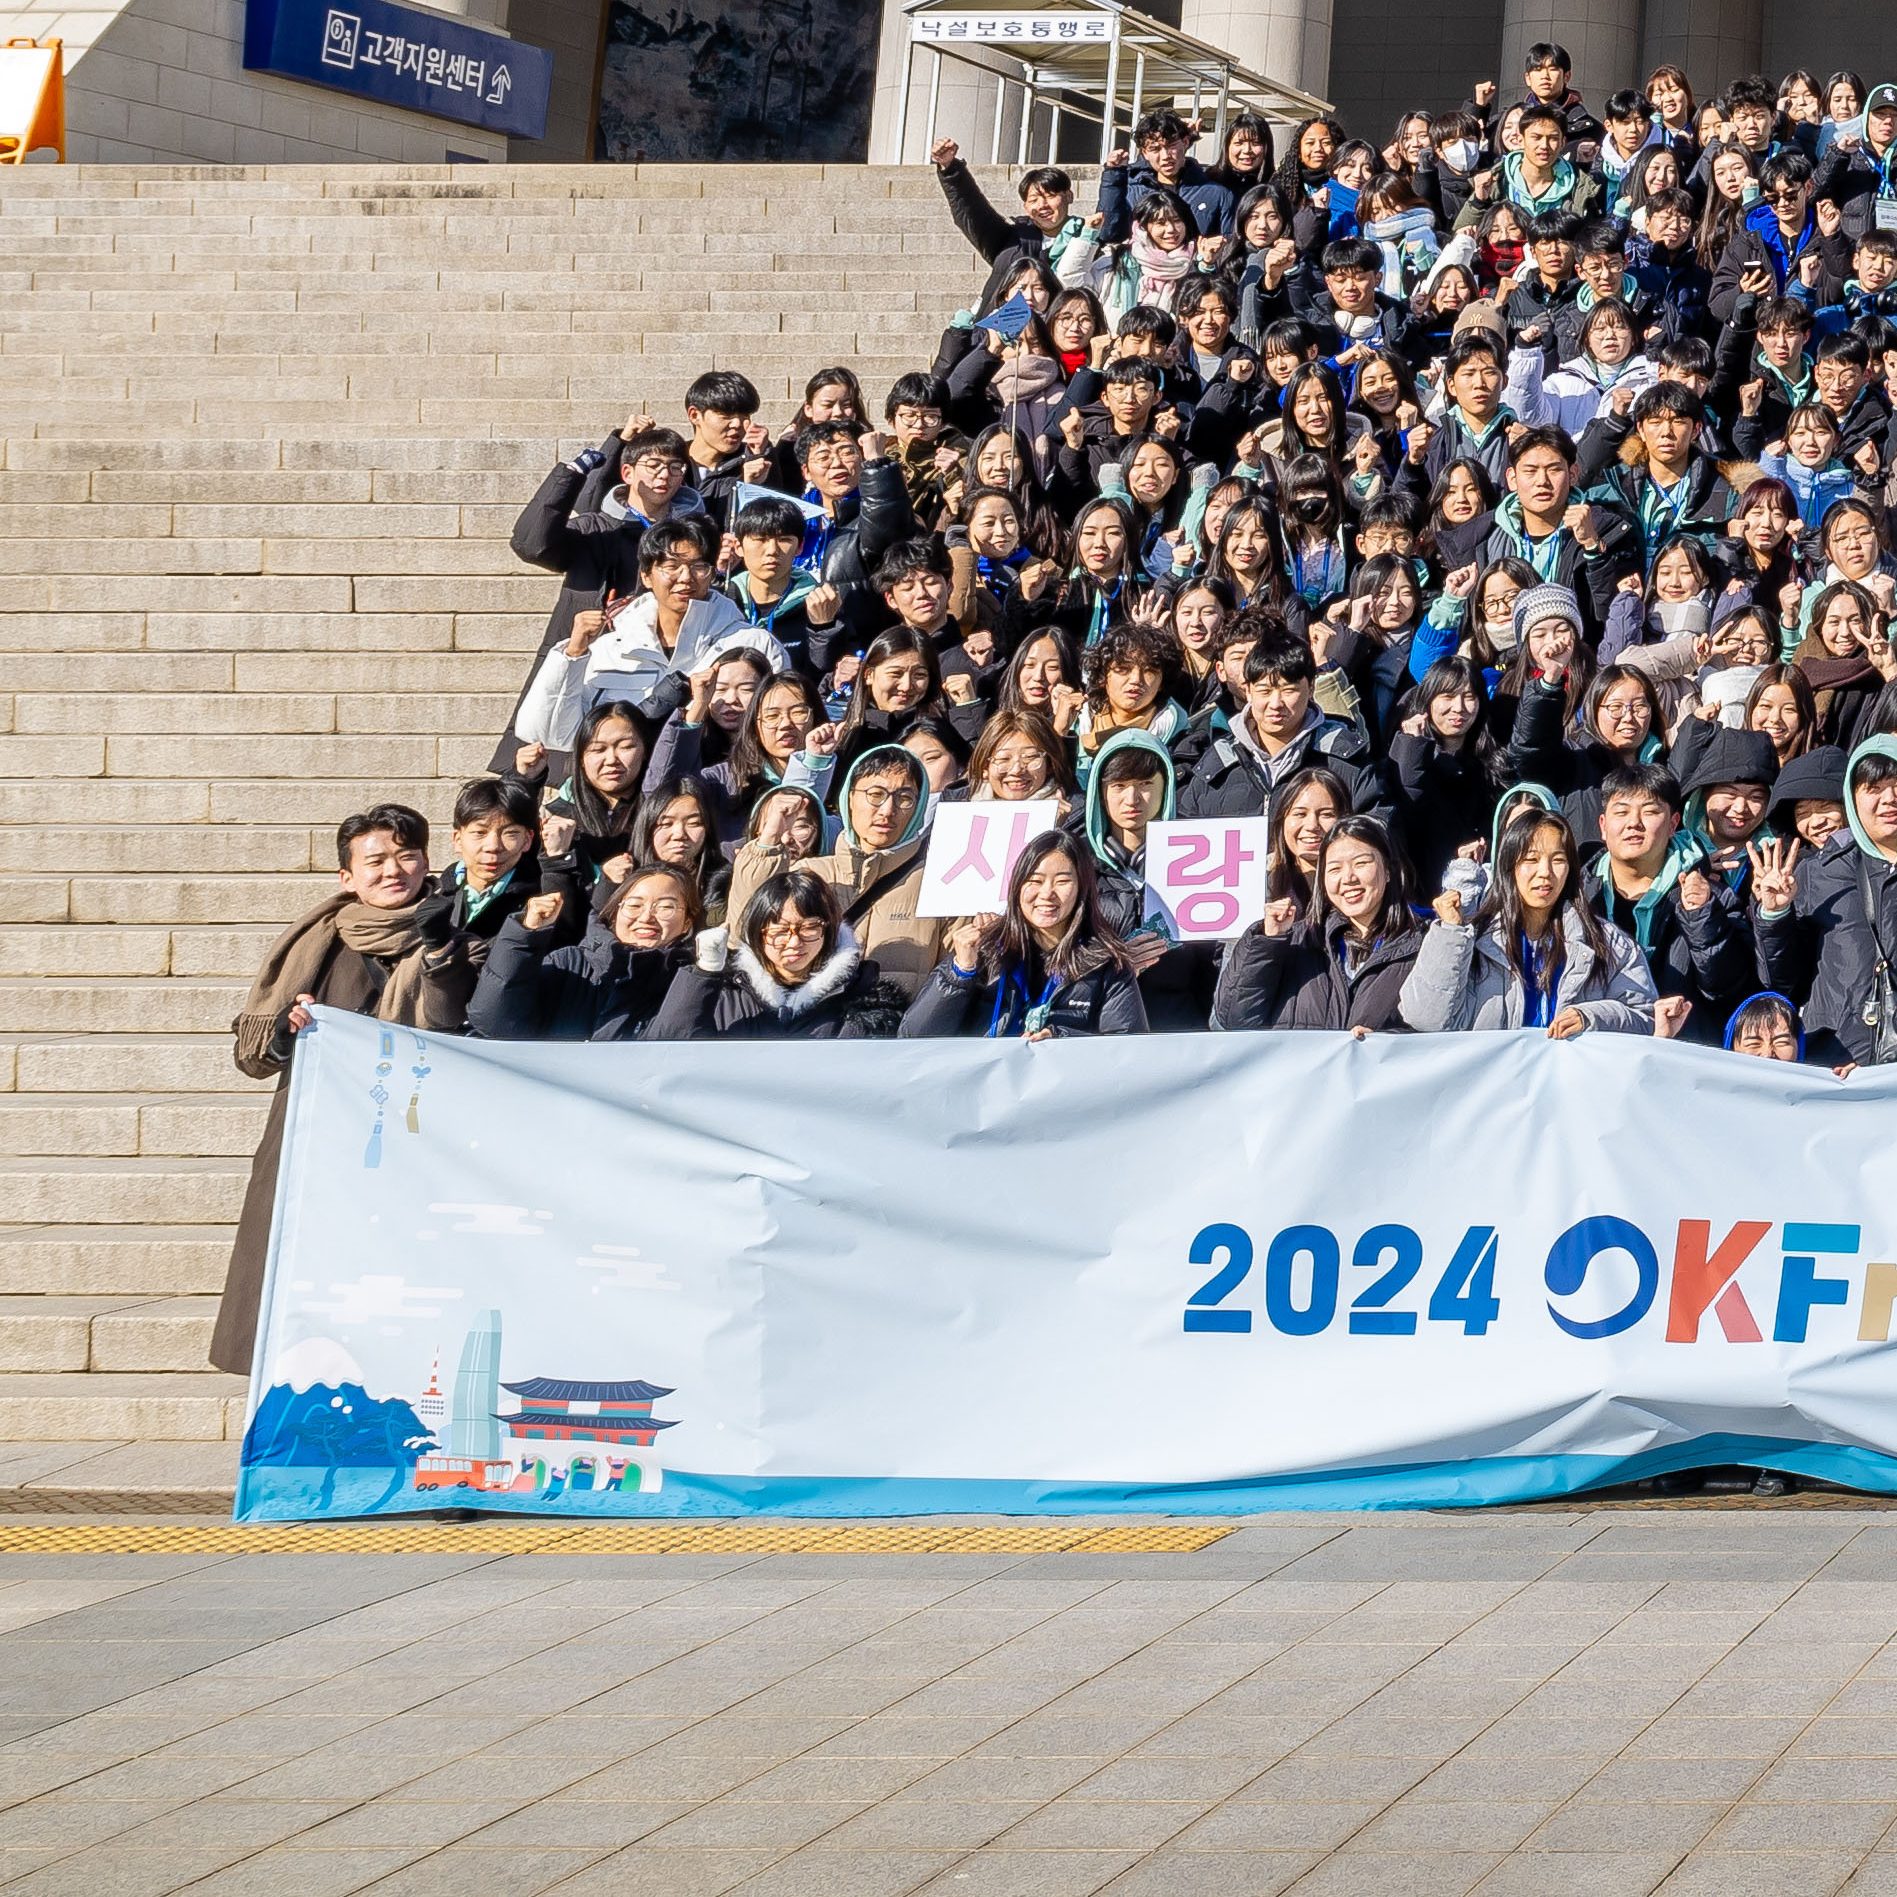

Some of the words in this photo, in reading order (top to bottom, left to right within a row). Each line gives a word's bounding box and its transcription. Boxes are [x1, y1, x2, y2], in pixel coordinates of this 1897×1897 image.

[359, 30, 485, 99] 고객지원센터
[921, 20, 1106, 38] 낙설보호통행로
[1166, 830, 1255, 933] 랑
[1183, 1223, 1500, 1336] 2024
